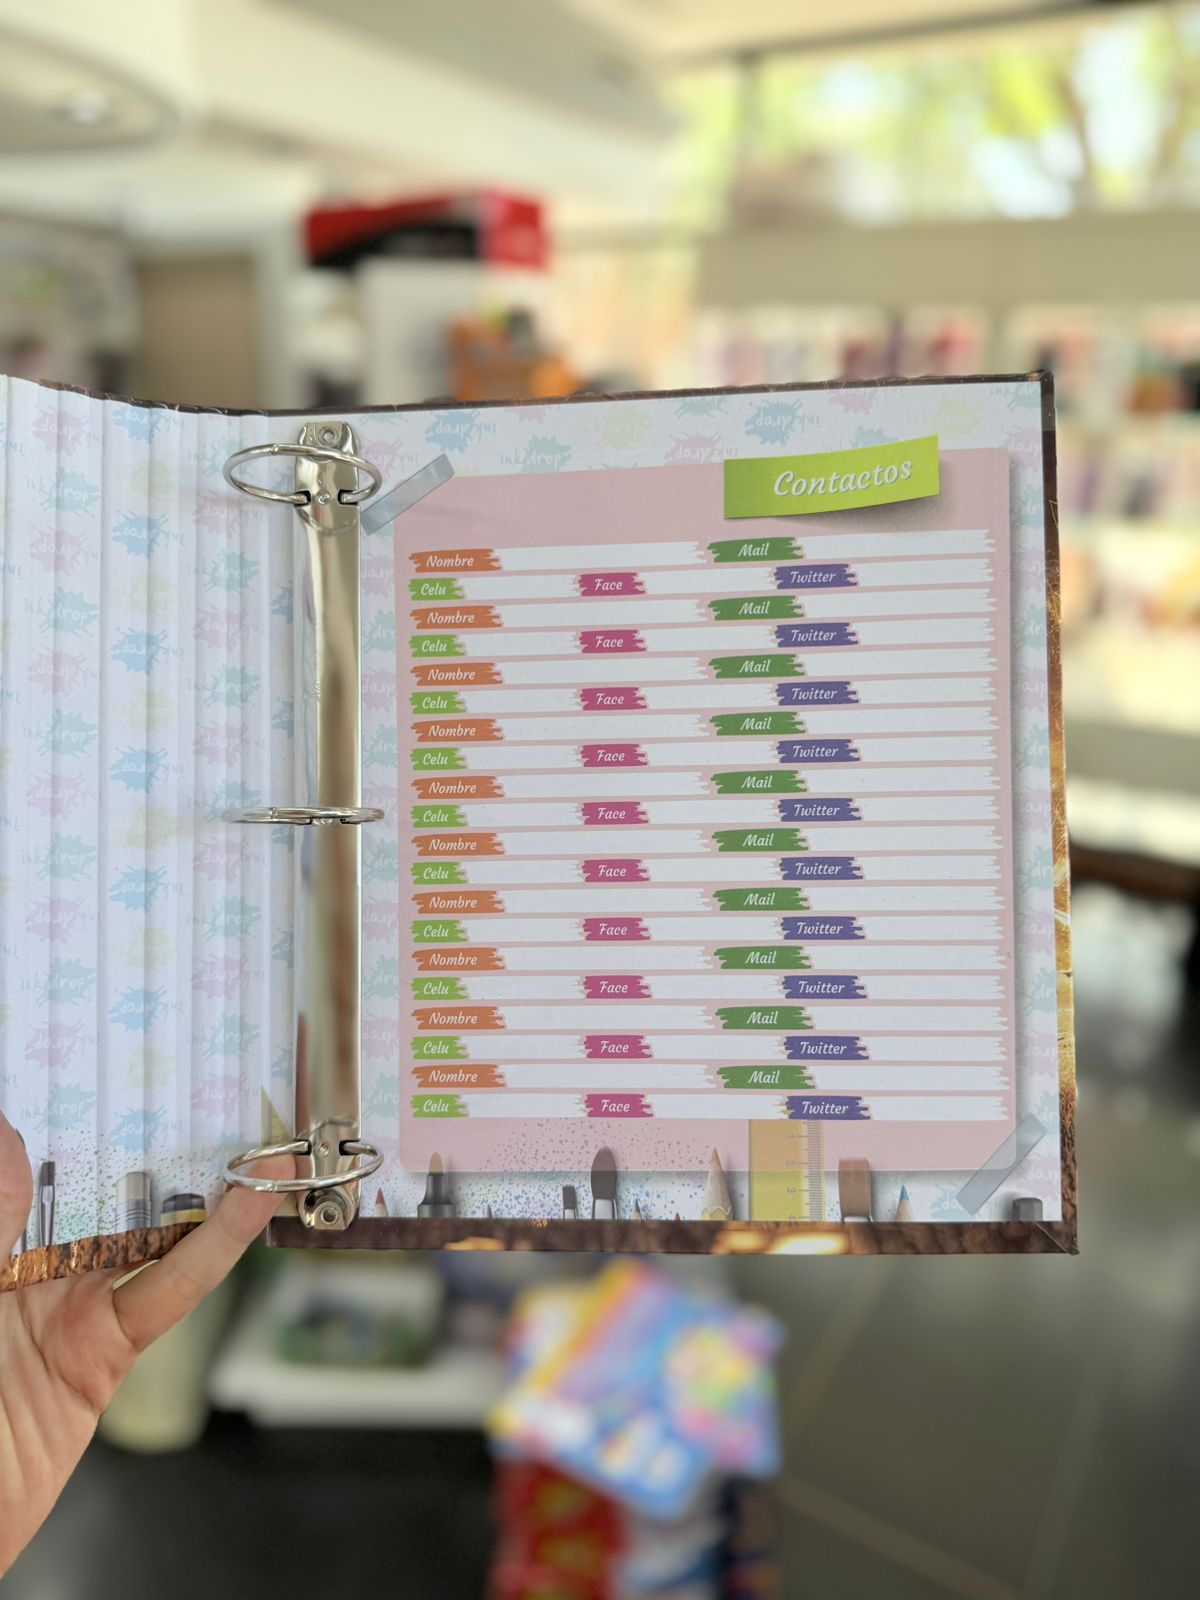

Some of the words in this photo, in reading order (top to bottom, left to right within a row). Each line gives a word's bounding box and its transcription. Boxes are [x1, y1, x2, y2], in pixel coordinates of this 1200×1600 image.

[755, 410, 794, 429] drop
[529, 449, 562, 468] drop
[773, 459, 913, 498] Contactos
[737, 543, 769, 557] Mail
[426, 554, 474, 568] Nombre
[594, 577, 624, 590] Face
[789, 570, 836, 584] Twitter
[420, 584, 447, 596] Celu
[738, 601, 770, 615] Mail
[427, 611, 475, 625] Nombre
[595, 634, 625, 647] Face
[790, 628, 837, 642] Twitter
[421, 641, 448, 653] Celu
[739, 659, 771, 673] Mail
[428, 667, 476, 681] Nombre
[596, 691, 626, 704] Face
[790, 687, 837, 701] Twitter
[422, 697, 449, 709] Celu
[428, 724, 476, 738] Nombre
[739, 717, 771, 731] Mail
[596, 748, 626, 761] Face
[792, 744, 839, 758] Twitter
[422, 754, 449, 766] Celu
[429, 781, 477, 795] Nombre
[740, 775, 772, 789] Mail
[422, 811, 449, 823] Celu
[597, 806, 627, 819] Face
[793, 803, 840, 817] Twitter
[429, 838, 477, 852] Nombre
[742, 833, 774, 847] Mail
[423, 868, 450, 880] Celu
[598, 863, 628, 876] Face
[794, 862, 841, 876] Twitter
[429, 895, 477, 909] Nombre
[743, 892, 775, 906] Mail
[423, 926, 450, 938] Celu
[598, 922, 628, 935] Face
[796, 922, 843, 936] Twitter
[429, 952, 477, 966] Nombre
[744, 951, 776, 965] Mail
[423, 983, 450, 995] Celu
[599, 980, 629, 993] Face
[798, 980, 845, 994] Twitter
[429, 1011, 477, 1025] Nombre
[746, 1011, 778, 1025] Mail
[423, 1042, 450, 1054] Celu
[600, 1039, 630, 1052] Face
[799, 1041, 846, 1055] Twitter
[429, 1069, 477, 1083] Nombre
[748, 1070, 780, 1084] Mail
[423, 1101, 450, 1113] Celu
[601, 1098, 631, 1111] Face
[801, 1101, 848, 1115] Twitter
